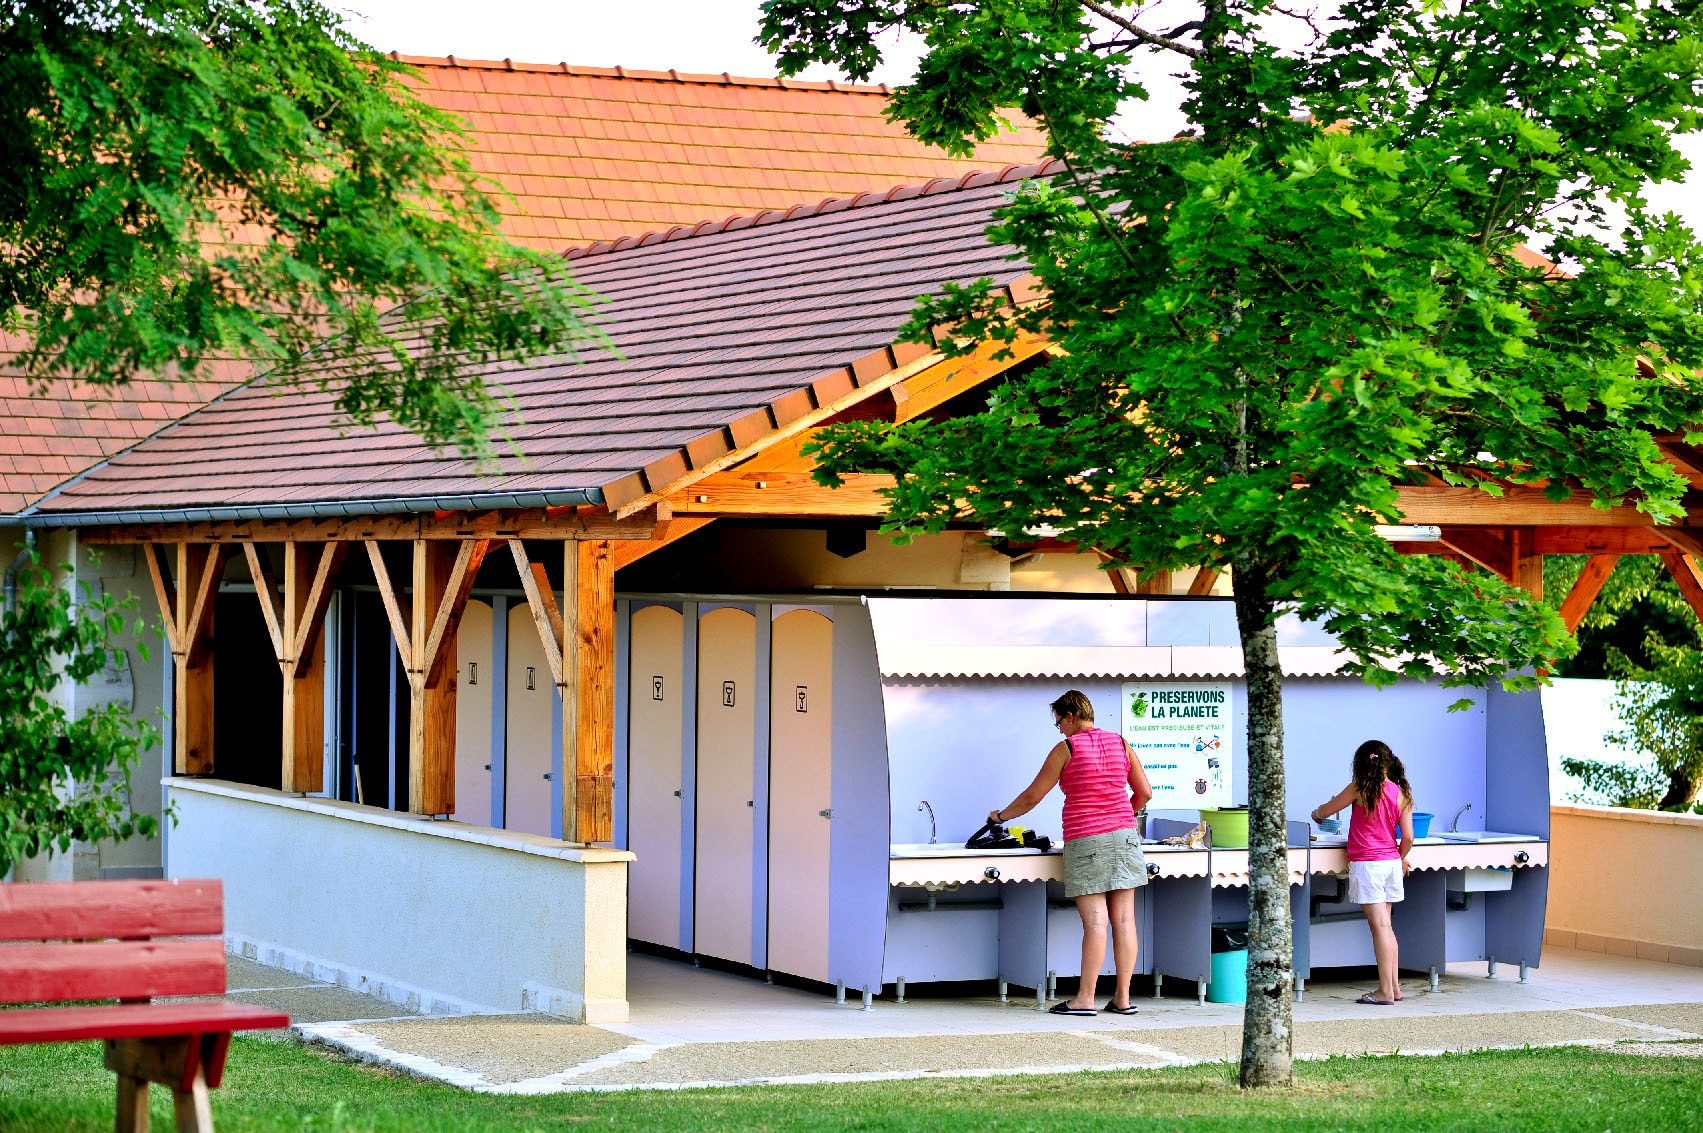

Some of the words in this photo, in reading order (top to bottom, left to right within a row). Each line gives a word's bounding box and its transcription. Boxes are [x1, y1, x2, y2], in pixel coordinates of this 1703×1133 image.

[1152, 691, 1224, 703] PRESERVONS
[1152, 706, 1165, 718] LA
[1169, 706, 1219, 717] PLANETE
